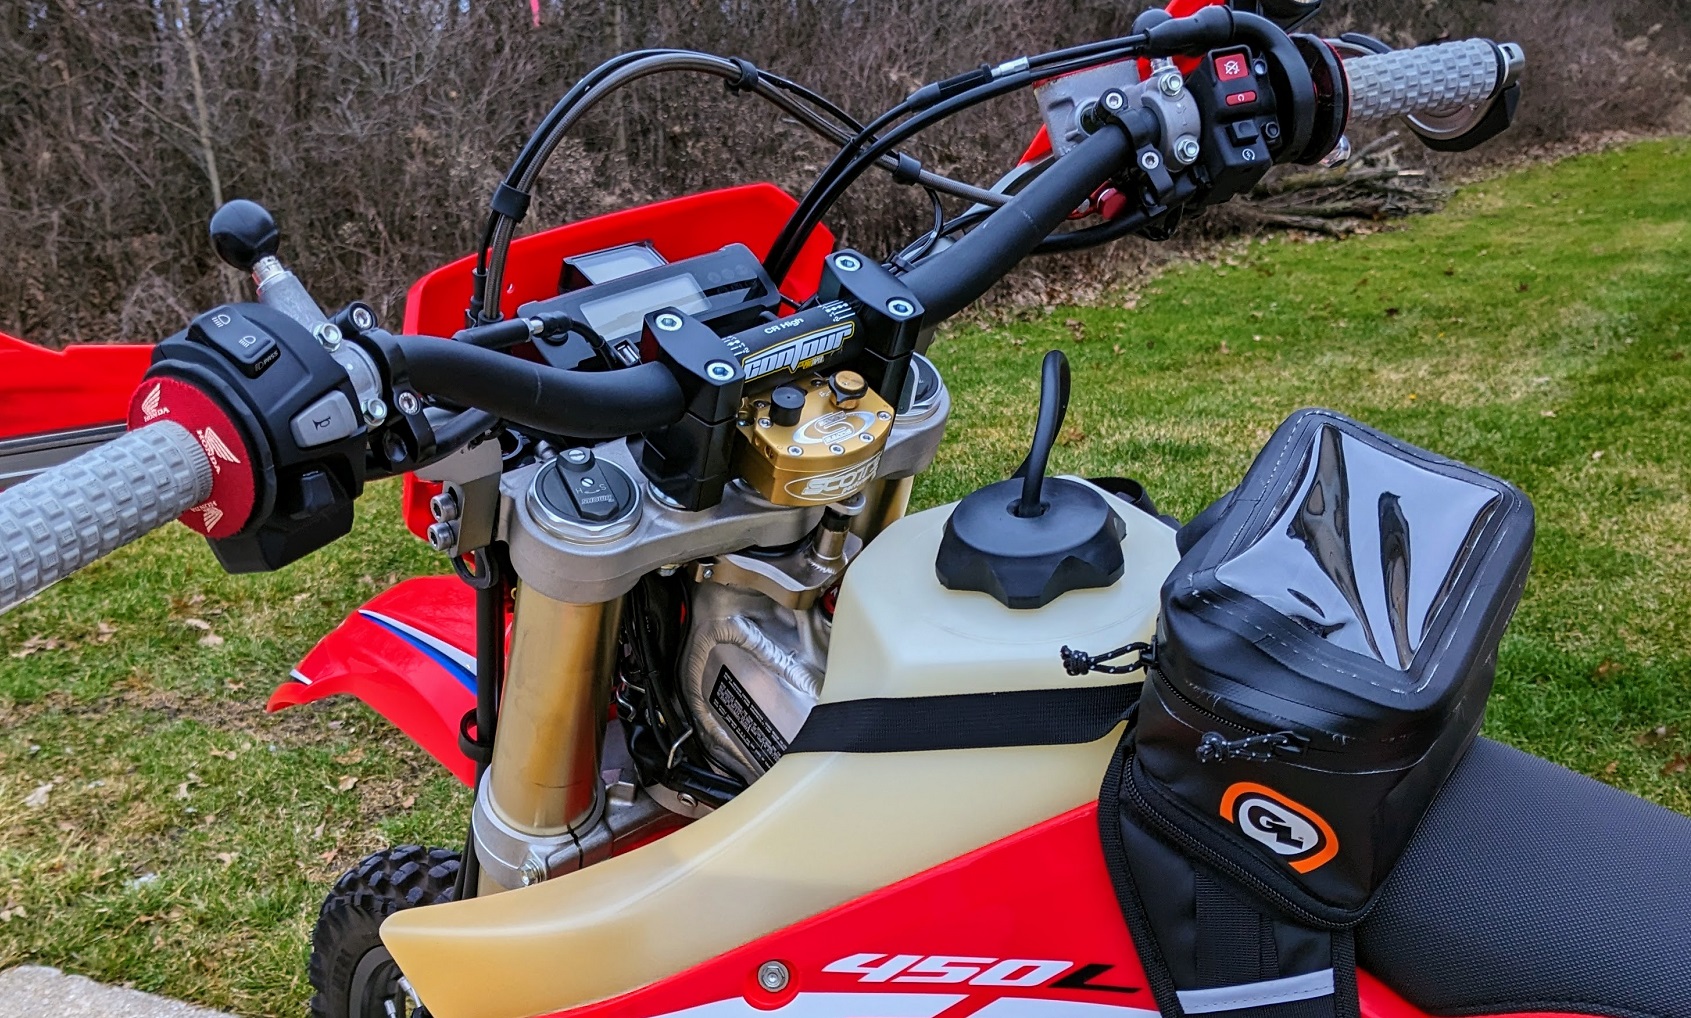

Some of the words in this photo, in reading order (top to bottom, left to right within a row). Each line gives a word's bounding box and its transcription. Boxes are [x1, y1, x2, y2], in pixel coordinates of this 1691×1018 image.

[764, 323, 781, 334] CR
[781, 317, 805, 329] High
[143, 407, 170, 422] HONDA
[196, 429, 221, 475] HONDA
